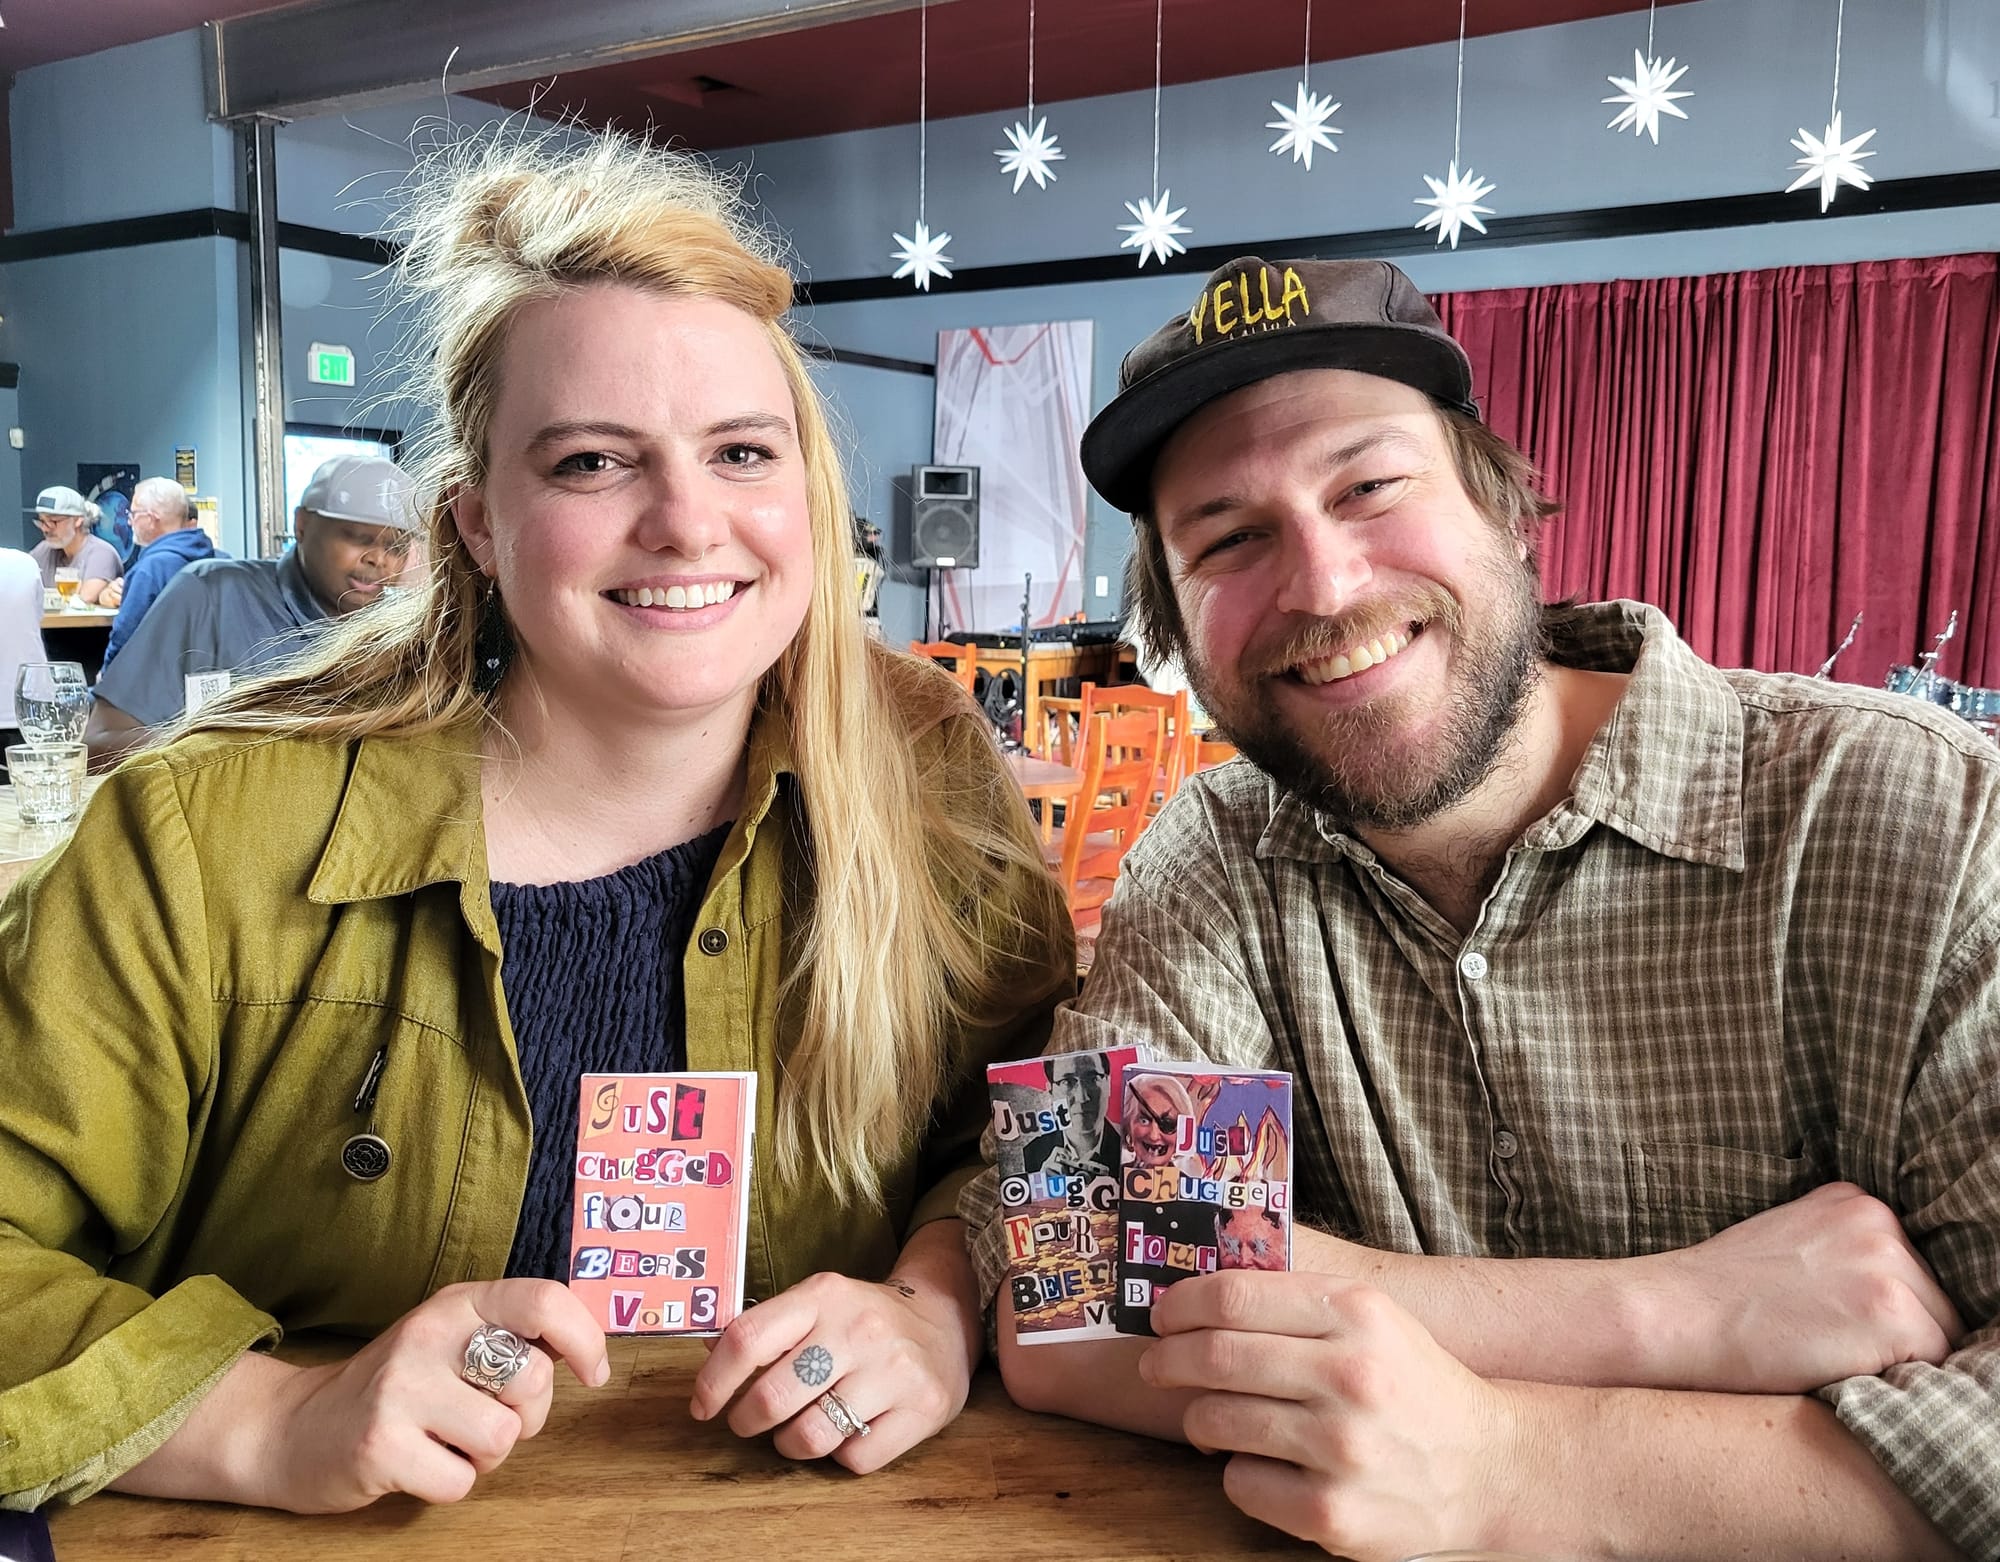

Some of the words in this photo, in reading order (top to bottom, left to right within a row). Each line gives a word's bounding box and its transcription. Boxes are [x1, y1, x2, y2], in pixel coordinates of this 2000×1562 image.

[1189, 266, 1311, 346] YELLA
[1000, 1103, 1071, 1135] Just
[1179, 1117, 1244, 1154] Just
[691, 1287, 717, 1324] 3
[1011, 1262, 1117, 1312] BEEr
